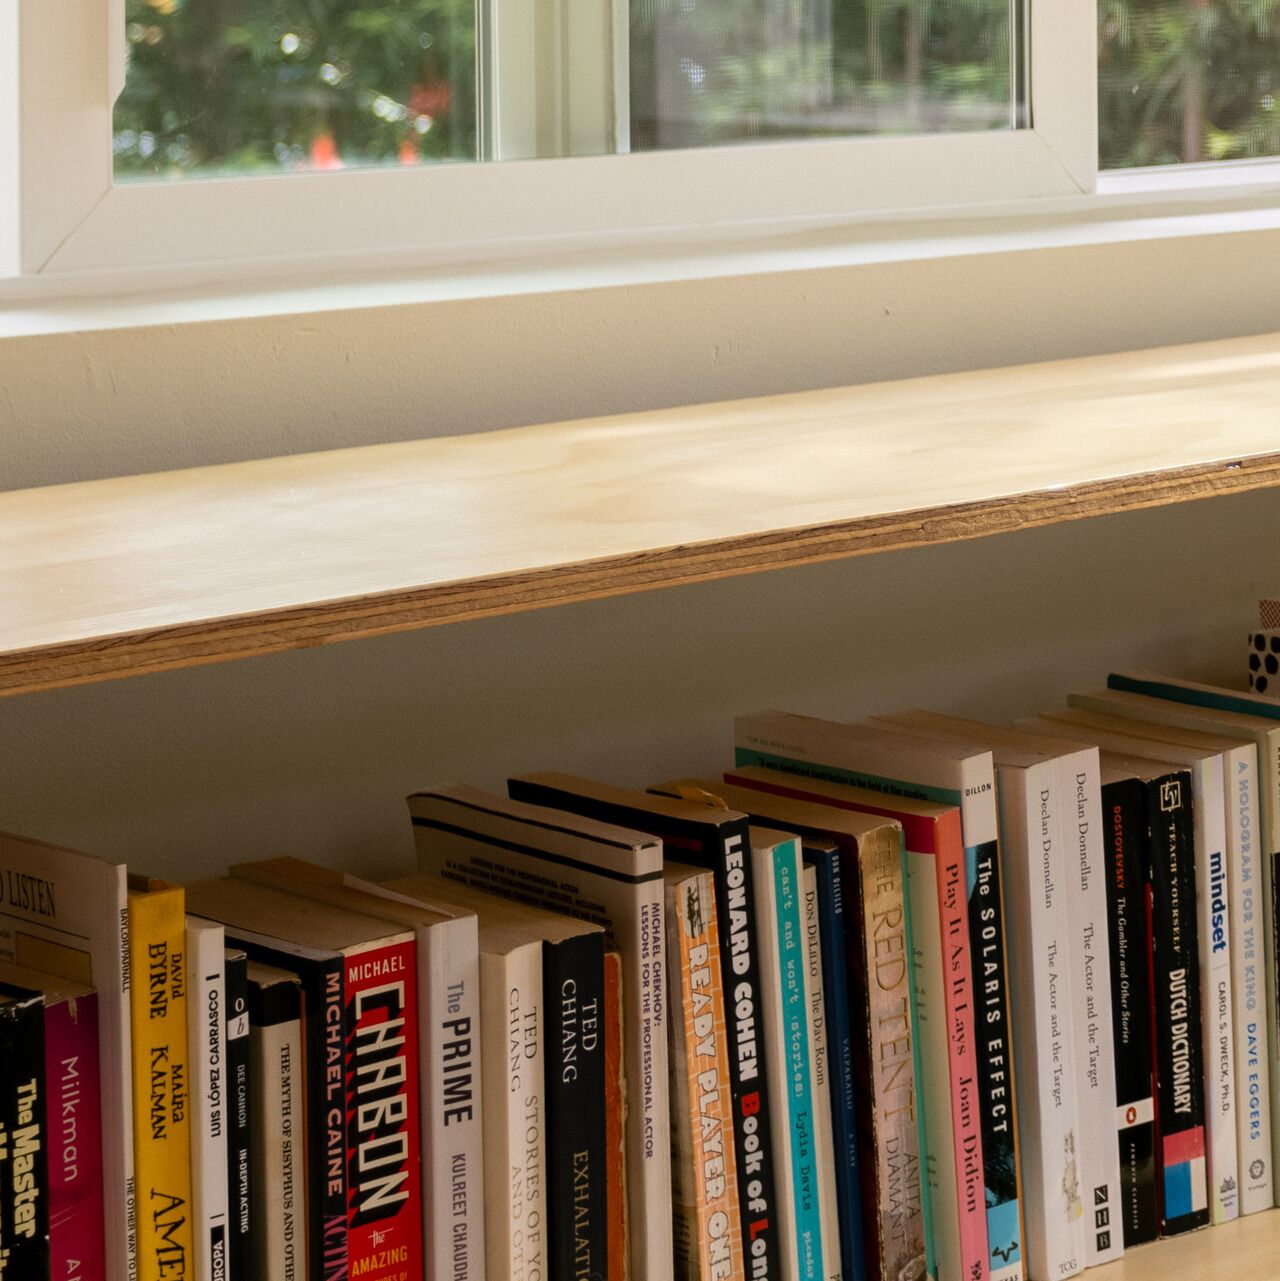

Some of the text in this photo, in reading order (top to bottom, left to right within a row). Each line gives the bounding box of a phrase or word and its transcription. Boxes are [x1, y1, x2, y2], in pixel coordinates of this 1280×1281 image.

[965, 782, 992, 798] DILLON
[8, 871, 56, 918] LISTEN
[1075, 772, 1101, 1089] Declan Donnellan The Actor and the Target
[1113, 805, 1131, 1044] DOSTOYEVSKY The Gambler and Other Stories
[1209, 851, 1228, 954] mindset
[148, 941, 168, 1020] BYRNE
[349, 954, 406, 983] MICHAEL
[447, 980, 465, 1015] The
[651, 901, 662, 1027] MICHAEL CHEKHOV:
[723, 833, 759, 1083] LEONARD COHEN
[872, 840, 917, 1123] THE RED TENT
[977, 857, 1008, 1134] The SOLARIS EFFECT
[1168, 822, 1193, 1114] TEACH YOURSELF DUTCH DICTIONARY
[1218, 981, 1228, 1020] CAROL
[207, 989, 221, 1138] LUIS LÓPEZ CARRASCO
[441, 1016, 474, 1128] PRIME
[561, 978, 578, 1085] CHIANG
[581, 997, 599, 1052] TED
[641, 904, 654, 1159] LESSONS FOR THE PROFESSIONAL ACTOR
[1219, 1036, 1230, 1083] DWECK,
[60, 1055, 81, 1182] Milkman
[150, 1044, 169, 1140] KALMAN
[237, 1064, 247, 1128] DEE CANNON
[355, 980, 410, 1213] CHABON
[688, 942, 733, 1281] READY PLAYER ONE
[740, 1091, 764, 1176] Book
[1221, 1084, 1231, 1116] Ph.D.
[12, 1077, 41, 1239] The Master
[239, 1149, 249, 1234] IN-DEPTH ACTING
[451, 1152, 468, 1217] KULREET
[746, 1179, 768, 1214] of
[885, 1136, 908, 1247] DIAMANT
[902, 1152, 922, 1219] ANITA
[352, 1245, 409, 1278] AMAZING
[367, 1226, 394, 1249] the
